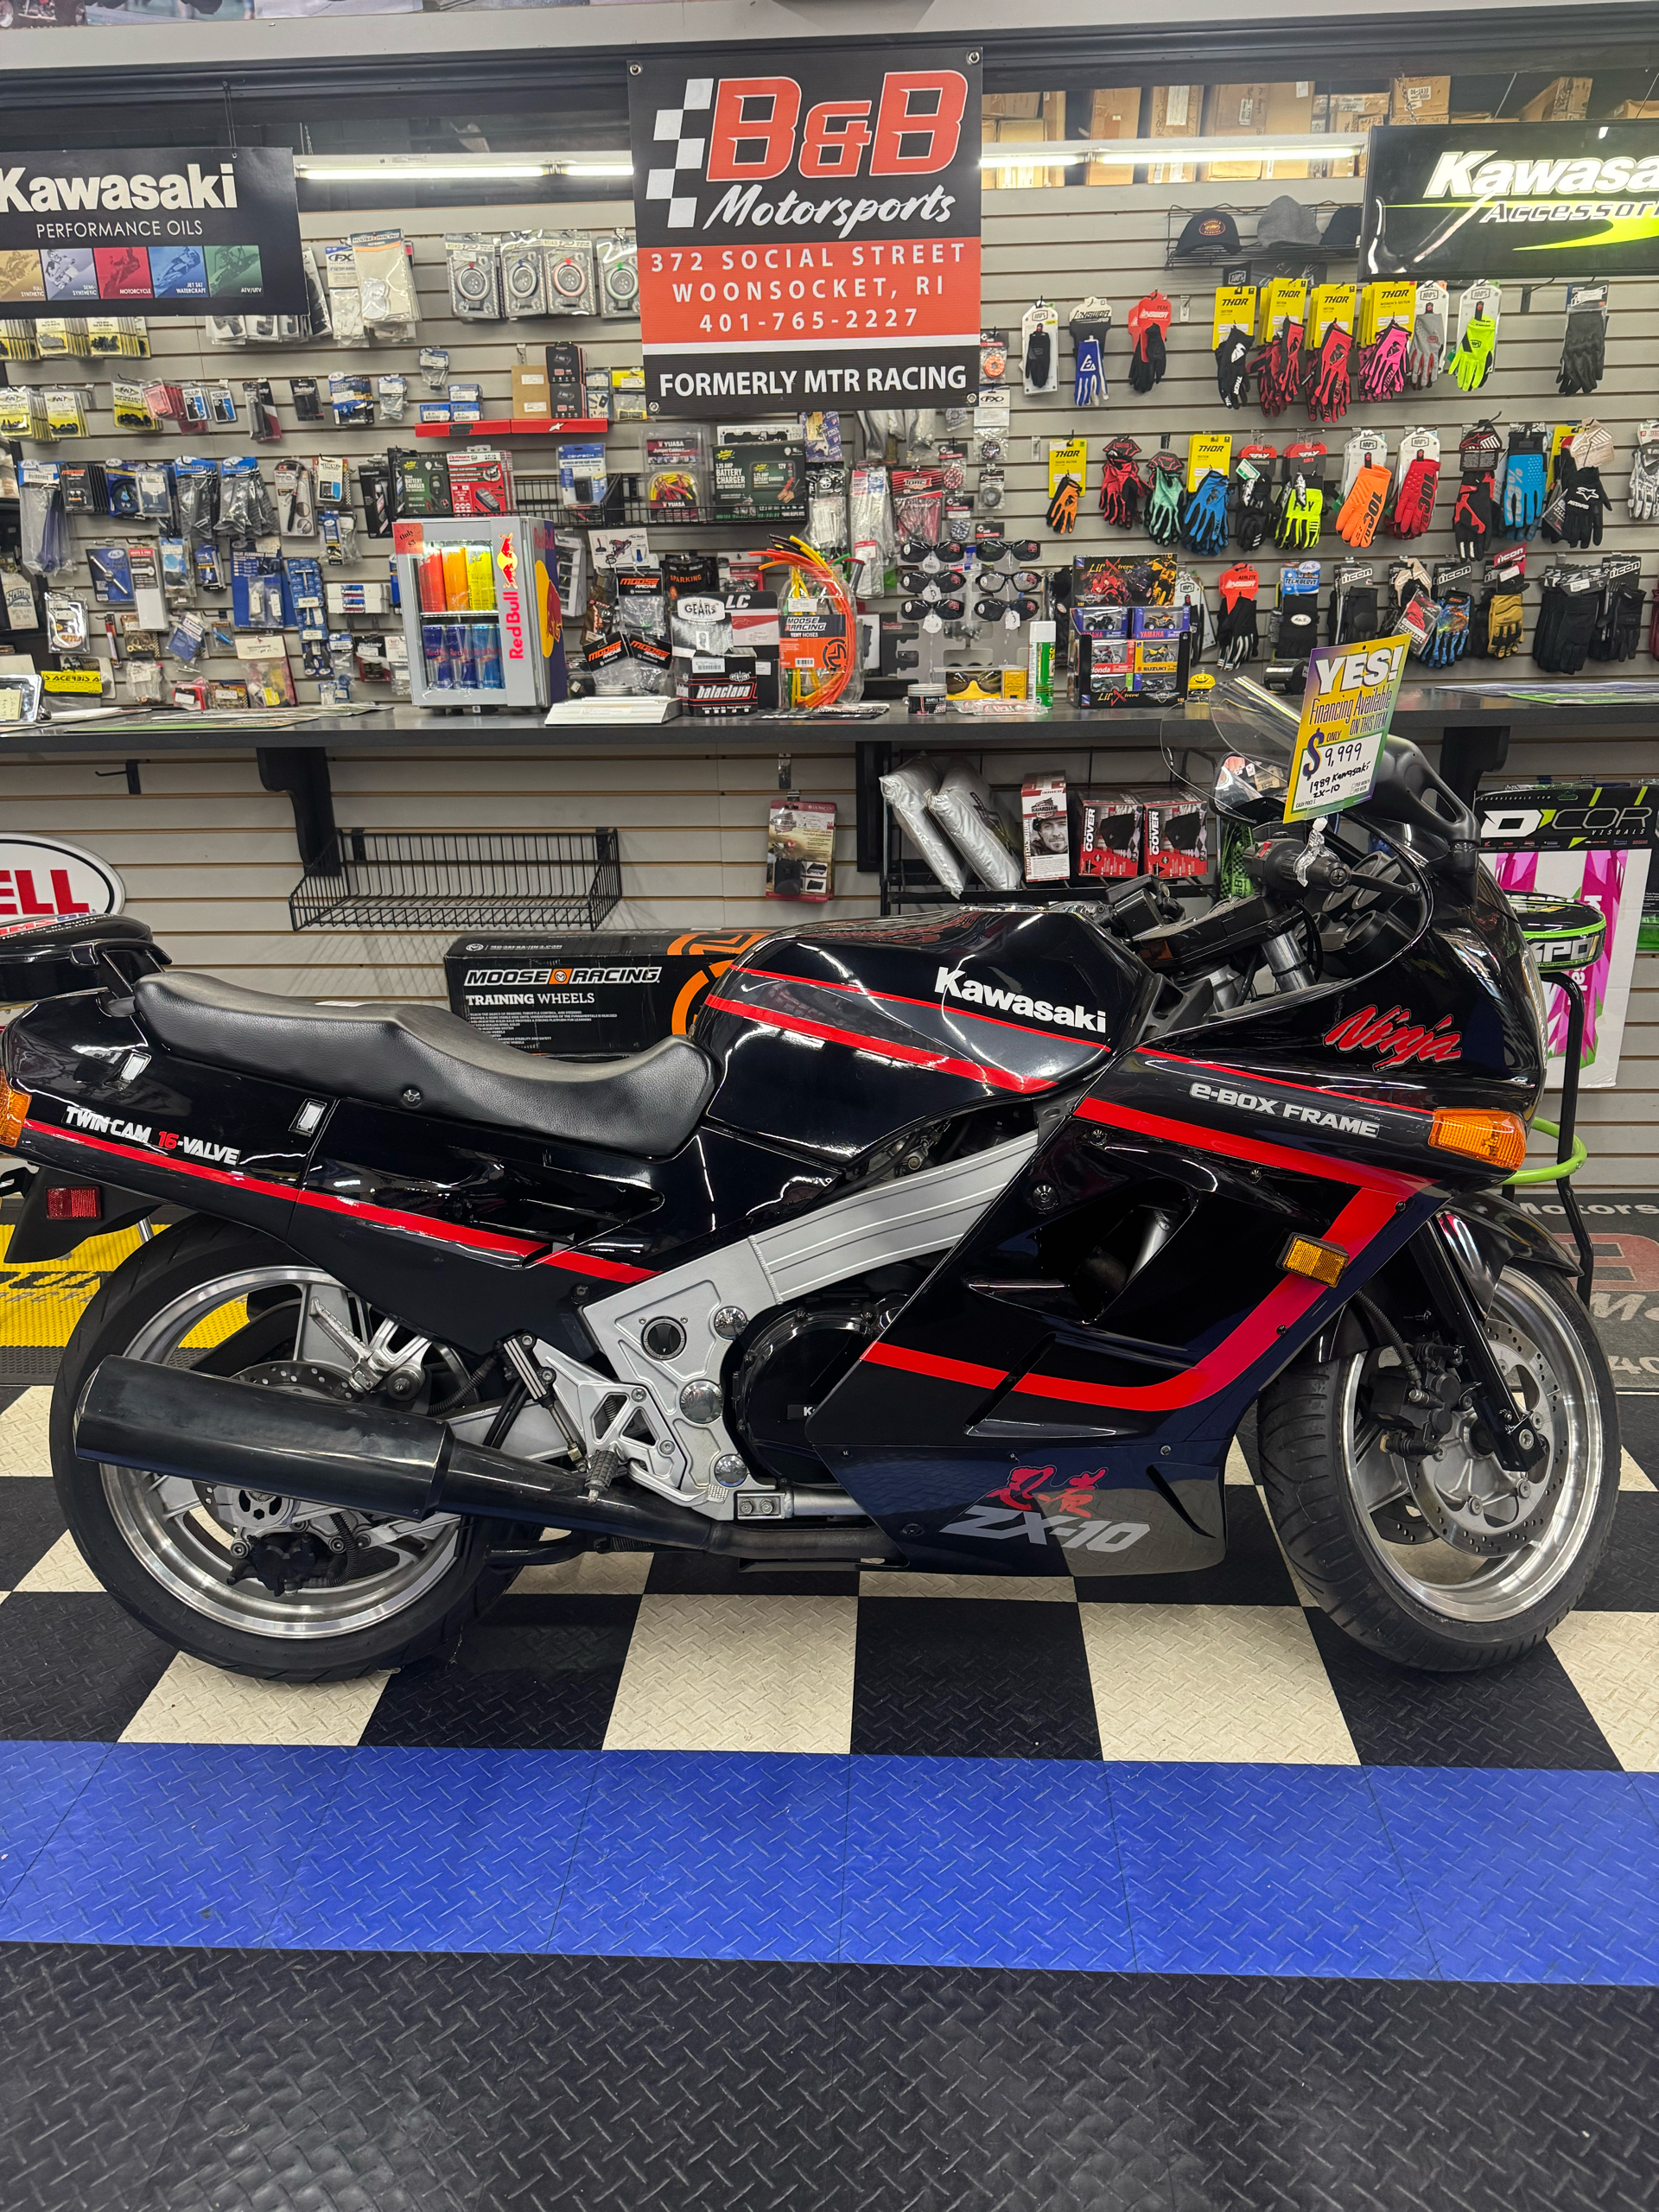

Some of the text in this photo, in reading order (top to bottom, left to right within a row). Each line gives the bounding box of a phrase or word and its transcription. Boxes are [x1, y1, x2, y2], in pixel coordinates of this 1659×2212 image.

[706, 69, 969, 182] B&B
[0, 162, 238, 213] Kawasaki
[702, 184, 956, 238] Motorsports
[36, 219, 203, 238] PERFORMANCE OILS
[652, 243, 965, 272] 372 SOCIAL STREET
[672, 276, 944, 302] WOONSOCKET, RI
[1277, 289, 1300, 298] THOR
[1325, 296, 1350, 304] THOR
[1382, 289, 1409, 298] THOR
[700, 308, 918, 333] 401-765-2227
[659, 365, 967, 397] FORMERLY MTR RACING
[715, 468, 742, 477] BATTERY
[399, 530, 414, 541] Only
[684, 599, 717, 619] GEARS
[726, 594, 751, 609] LC
[503, 591, 524, 659] Red Bull
[588, 640, 622, 662] MOOSE
[631, 640, 671, 658] MOOSE
[1315, 645, 1405, 696] YES!
[696, 683, 752, 700] balaclava
[1309, 683, 1393, 726] Financing Available
[1326, 730, 1342, 742] ONLY
[1350, 711, 1389, 736] ON THIS ITEM
[1302, 728, 1363, 781] $ 9,999
[1310, 776, 1331, 793] 1989
[1085, 808, 1096, 853] COVER
[464, 966, 662, 987] MOOSE RACING
[466, 993, 595, 1006] TRAINING WHEELS
[934, 967, 1107, 1033] Kawasaki
[1324, 1005, 1464, 1072] Ninja
[1190, 1081, 1380, 1138] e-BOX FRAME
[65, 1105, 242, 1166] TWIN CAM 16-VALVE
[939, 1504, 1151, 1554] ZX-10
